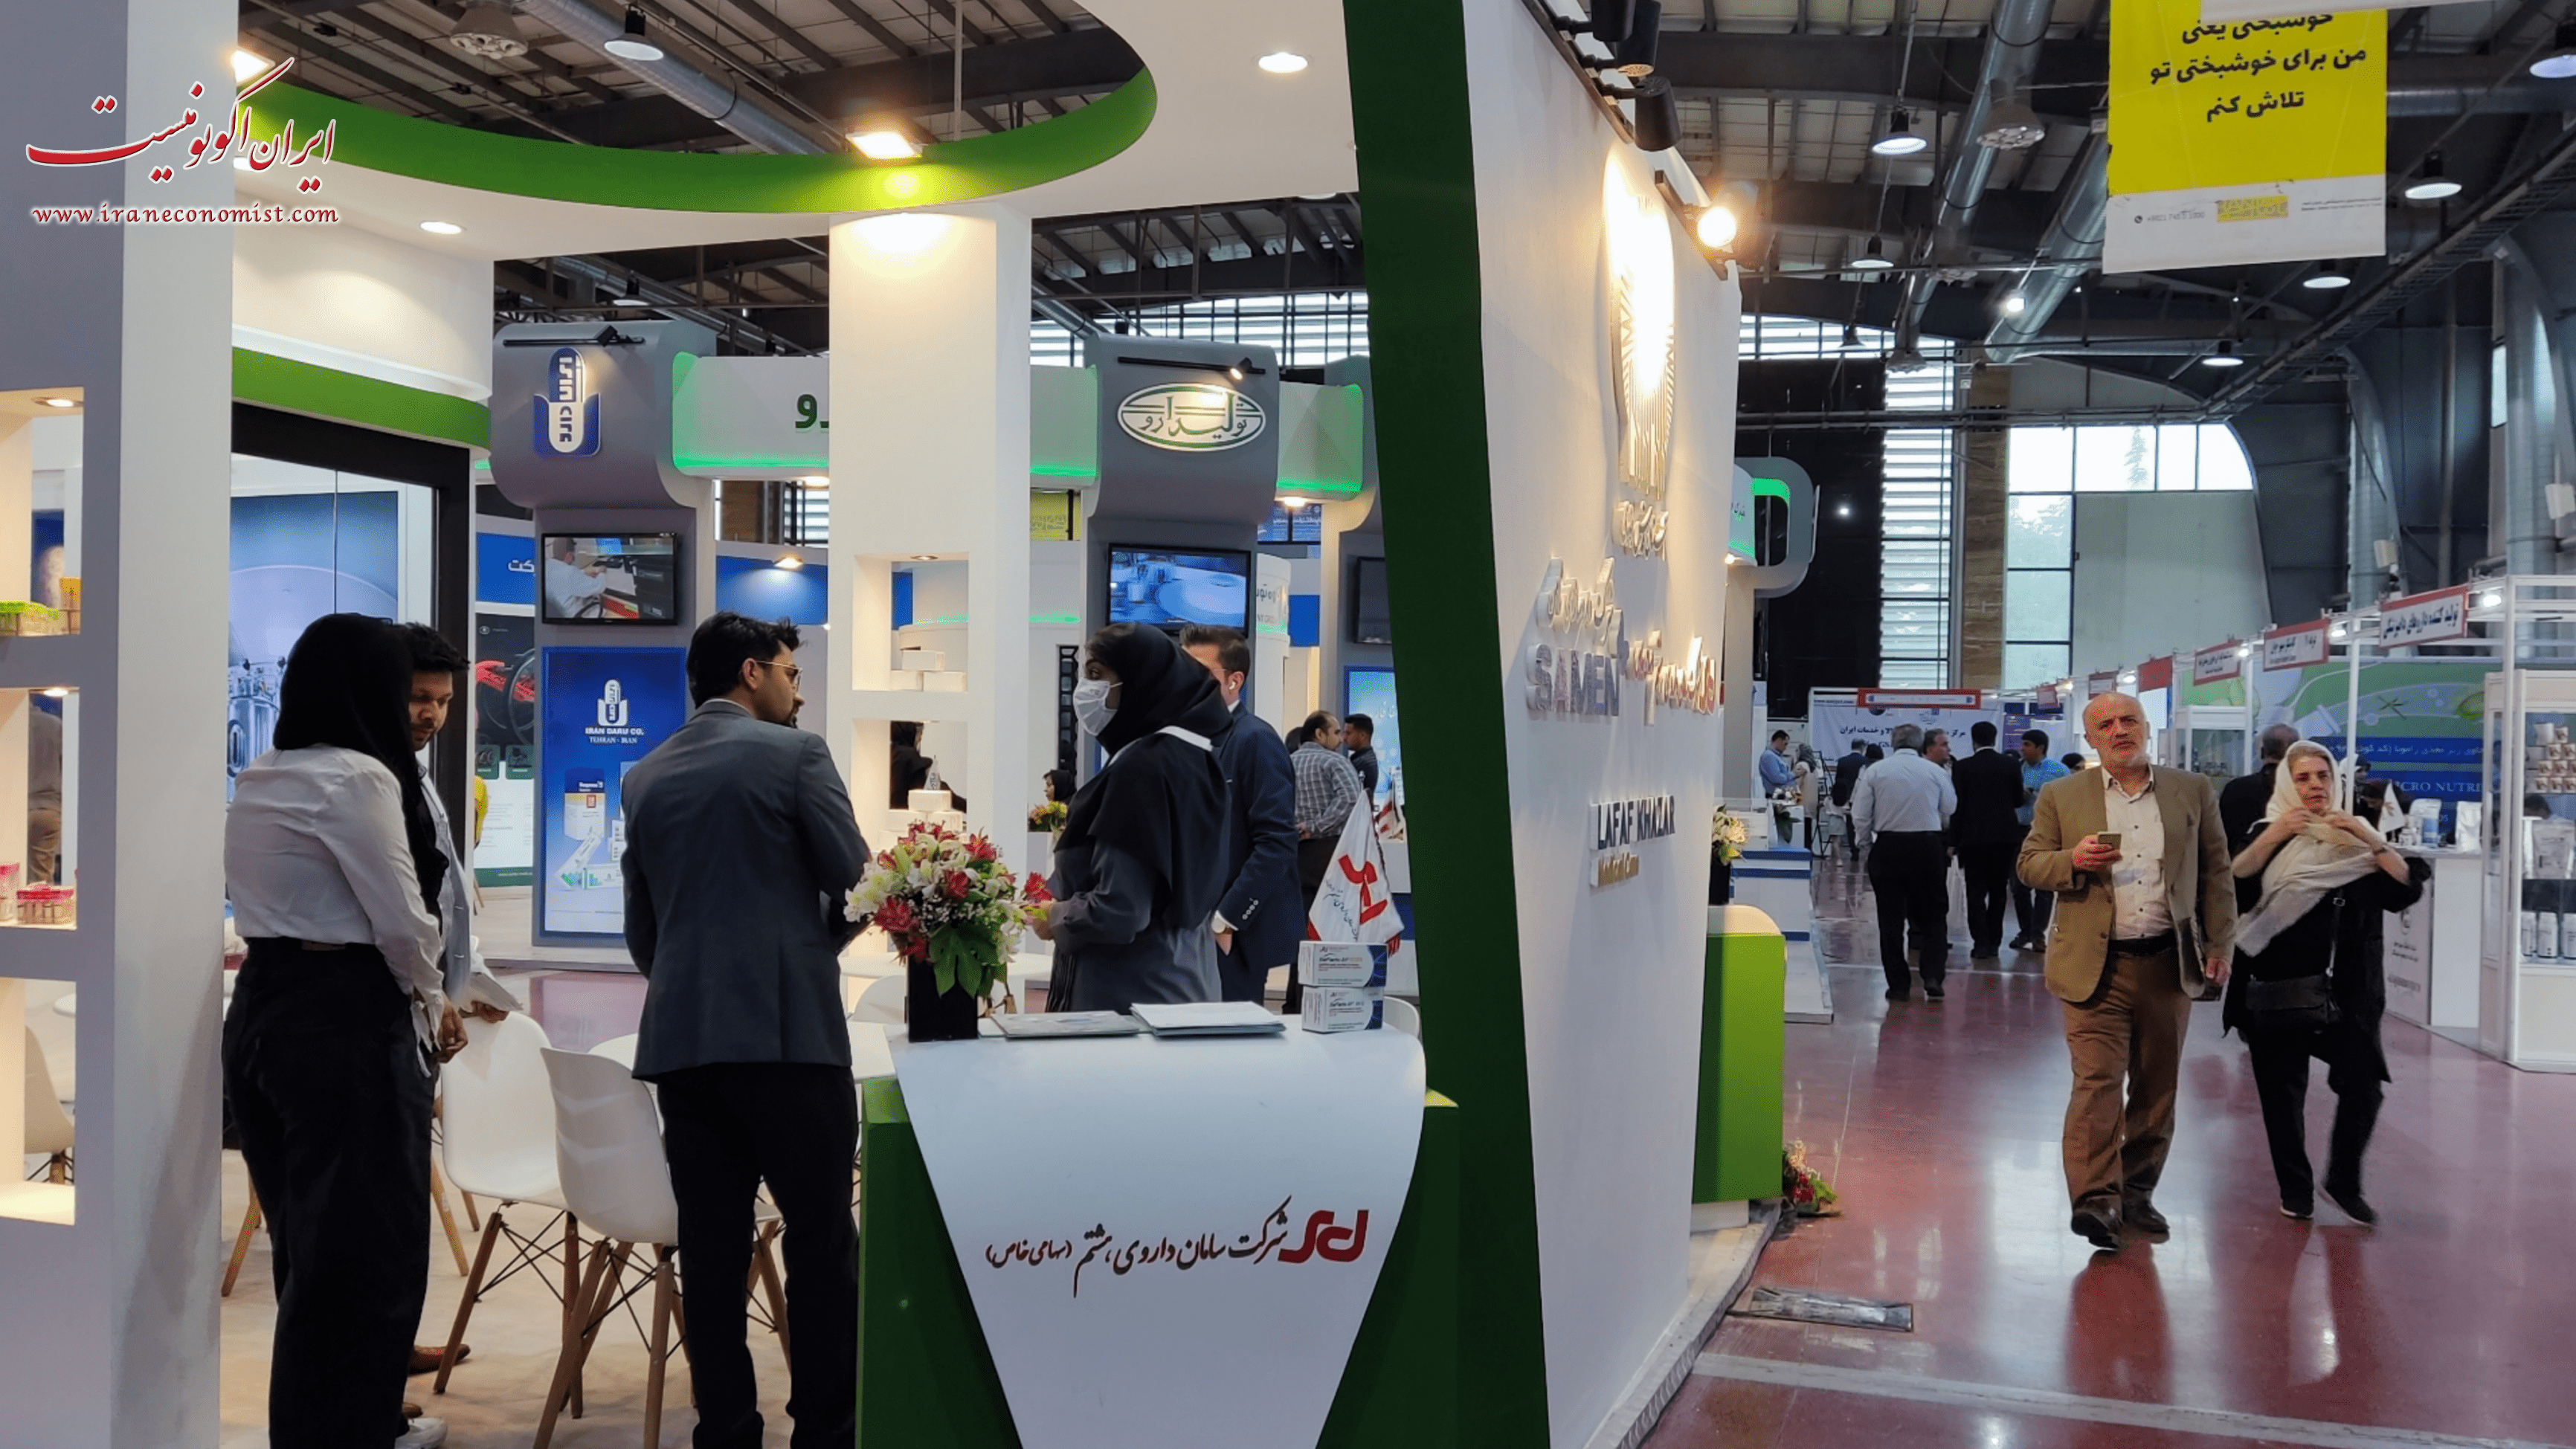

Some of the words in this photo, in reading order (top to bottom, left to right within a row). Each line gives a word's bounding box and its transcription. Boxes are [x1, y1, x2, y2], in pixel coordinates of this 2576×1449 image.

[2151, 62, 2171, 85] تو
[2177, 50, 2276, 83] خوشبختی
[2283, 48, 2326, 71] برای
[2334, 49, 2366, 69] من
[2206, 95, 2241, 123] کنم
[2247, 91, 2304, 117] تلاش
[1529, 644, 1619, 716] SAMEN
[2435, 782, 2482, 793] NUTRI
[1597, 800, 1634, 850] LAFAF
[1637, 795, 1675, 842] KHAZAR
[1229, 1195, 1292, 1265] شرکت
[1113, 1237, 1174, 1275] داروی
[1176, 1233, 1226, 1270] سامان
